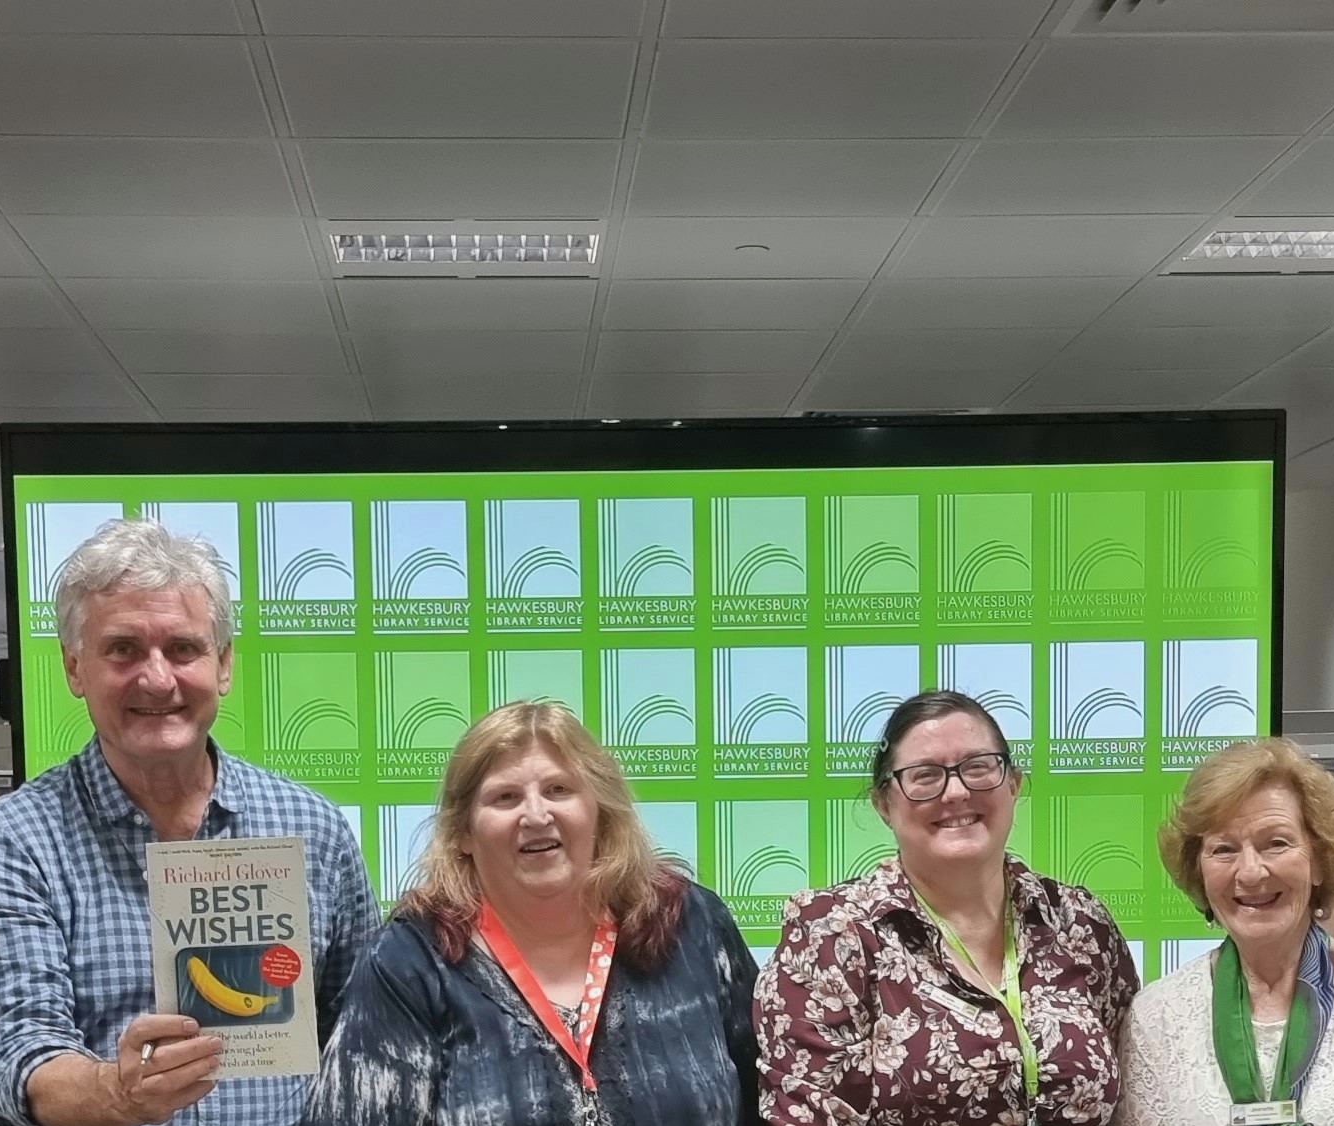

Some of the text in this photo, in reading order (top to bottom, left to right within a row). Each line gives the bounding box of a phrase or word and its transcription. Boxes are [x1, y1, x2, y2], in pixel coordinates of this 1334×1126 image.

[712, 598, 810, 611] HAWKESBURY
[825, 596, 922, 610] HAWKESBURY
[937, 595, 1035, 608] HAWKESBURY
[1049, 593, 1147, 606] HAWKESBURY
[259, 603, 357, 616] HAWKESBURY
[373, 602, 471, 615] HAWKESBURY
[485, 602, 585, 614] HAWKESBURY
[599, 600, 697, 613] HAWKESBURY
[1049, 607, 1145, 617] LIBRARY SERVICE
[485, 616, 583, 626] LIBRARY SERVICE
[599, 615, 695, 624] LIBRARY SERVICE
[712, 613, 808, 622] LIBRARY SERVICE
[825, 612, 921, 621] LIBRARY SERVICE
[937, 610, 1033, 620] LIBRARY SERVICE
[259, 618, 357, 628] LIBRARY SERVICE
[373, 618, 469, 627] LIBRARY SERVICE
[614, 748, 699, 761] AWKESBURY
[714, 747, 810, 760] HAWKESBURY
[825, 746, 878, 759] HAWKE
[1049, 742, 1147, 755] HAWKESBURY
[263, 752, 362, 766] HAWKESBURY
[377, 752, 450, 765] HAWKESB
[1049, 756, 1145, 766] LIBRARY SERVICE
[1161, 756, 1207, 766] LIBRARY
[315, 767, 361, 777] SERVICE
[377, 767, 423, 776] LIBRARY
[652, 762, 697, 772] SERVICE
[714, 761, 809, 772] LIBRARY SERVICE
[825, 761, 872, 770] LIBRARY
[163, 863, 291, 884] Richard Glover
[190, 884, 268, 914] BEST
[728, 899, 783, 912] AWKESB
[165, 914, 295, 946] WISHES
